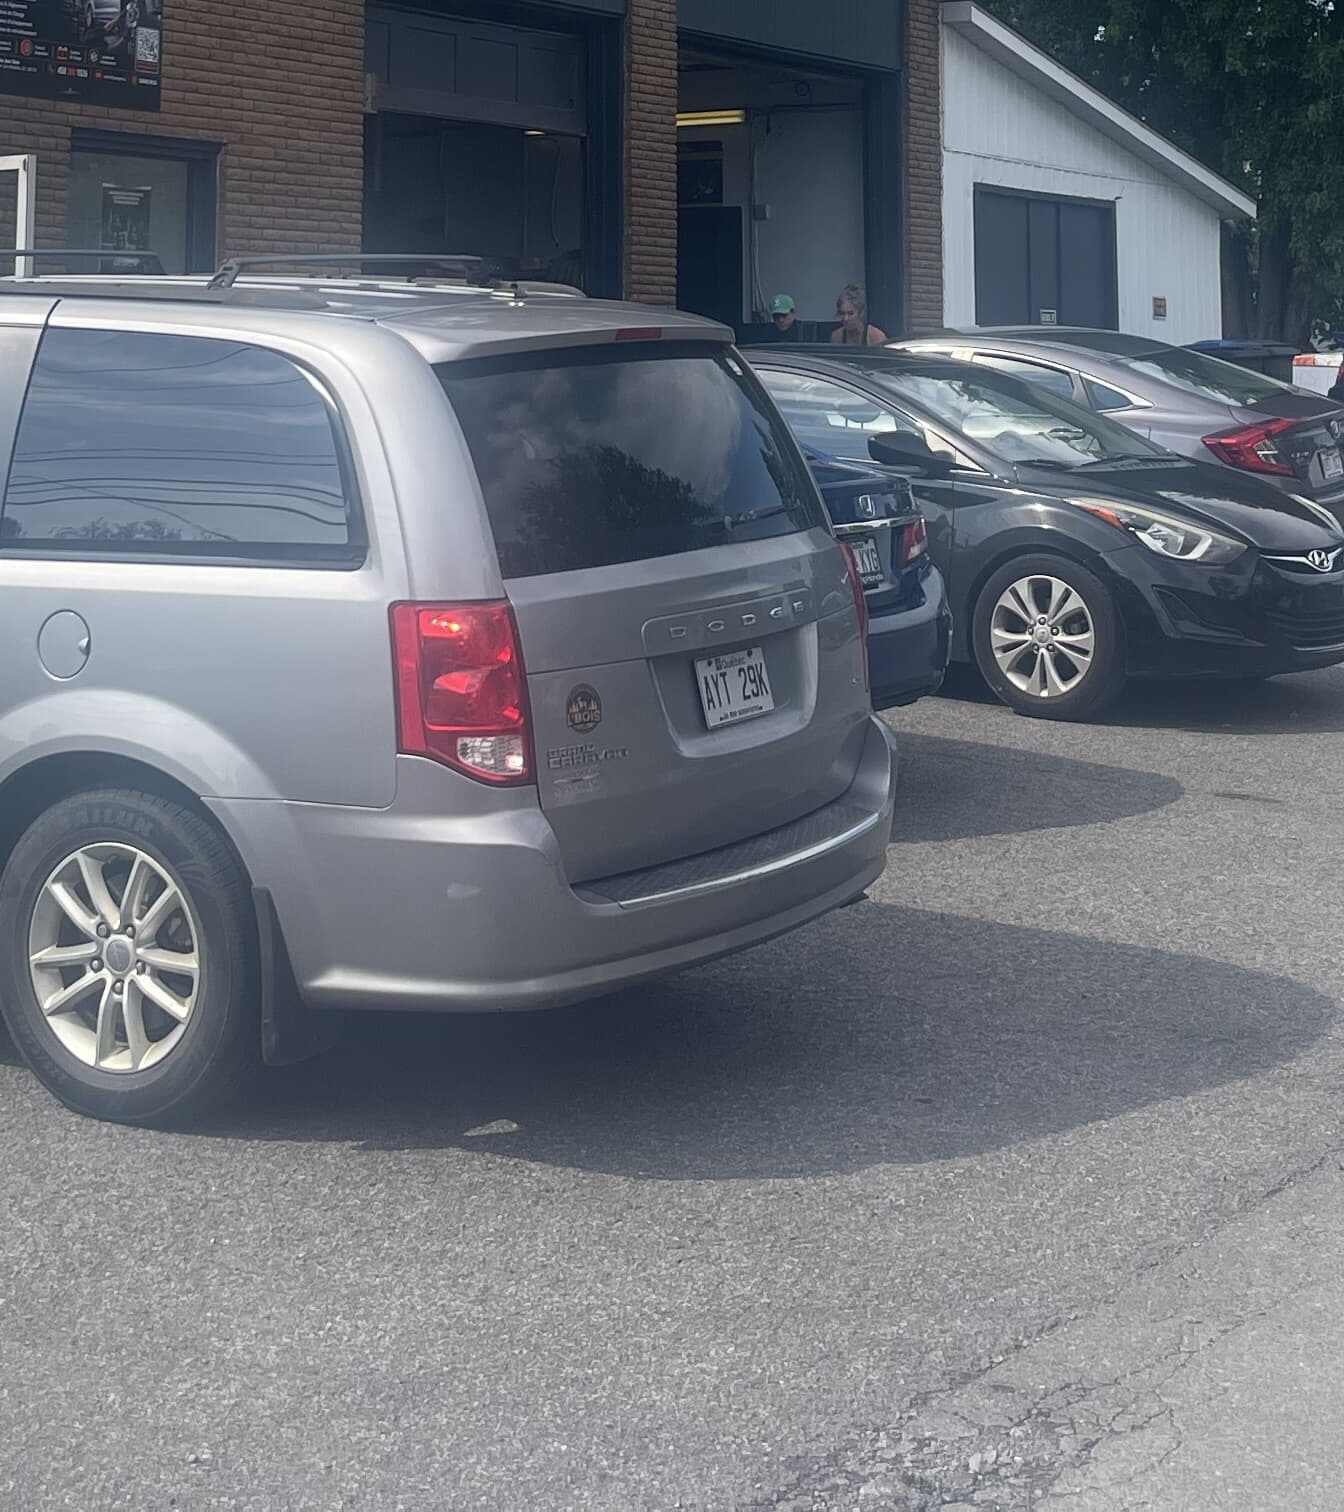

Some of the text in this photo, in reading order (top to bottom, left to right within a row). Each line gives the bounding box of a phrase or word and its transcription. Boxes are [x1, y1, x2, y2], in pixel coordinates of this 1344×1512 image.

[670, 600, 804, 638] DODGE
[703, 662, 769, 711] AYT 29K
[548, 744, 596, 758] GRAND
[548, 749, 630, 769] CARAVAN
